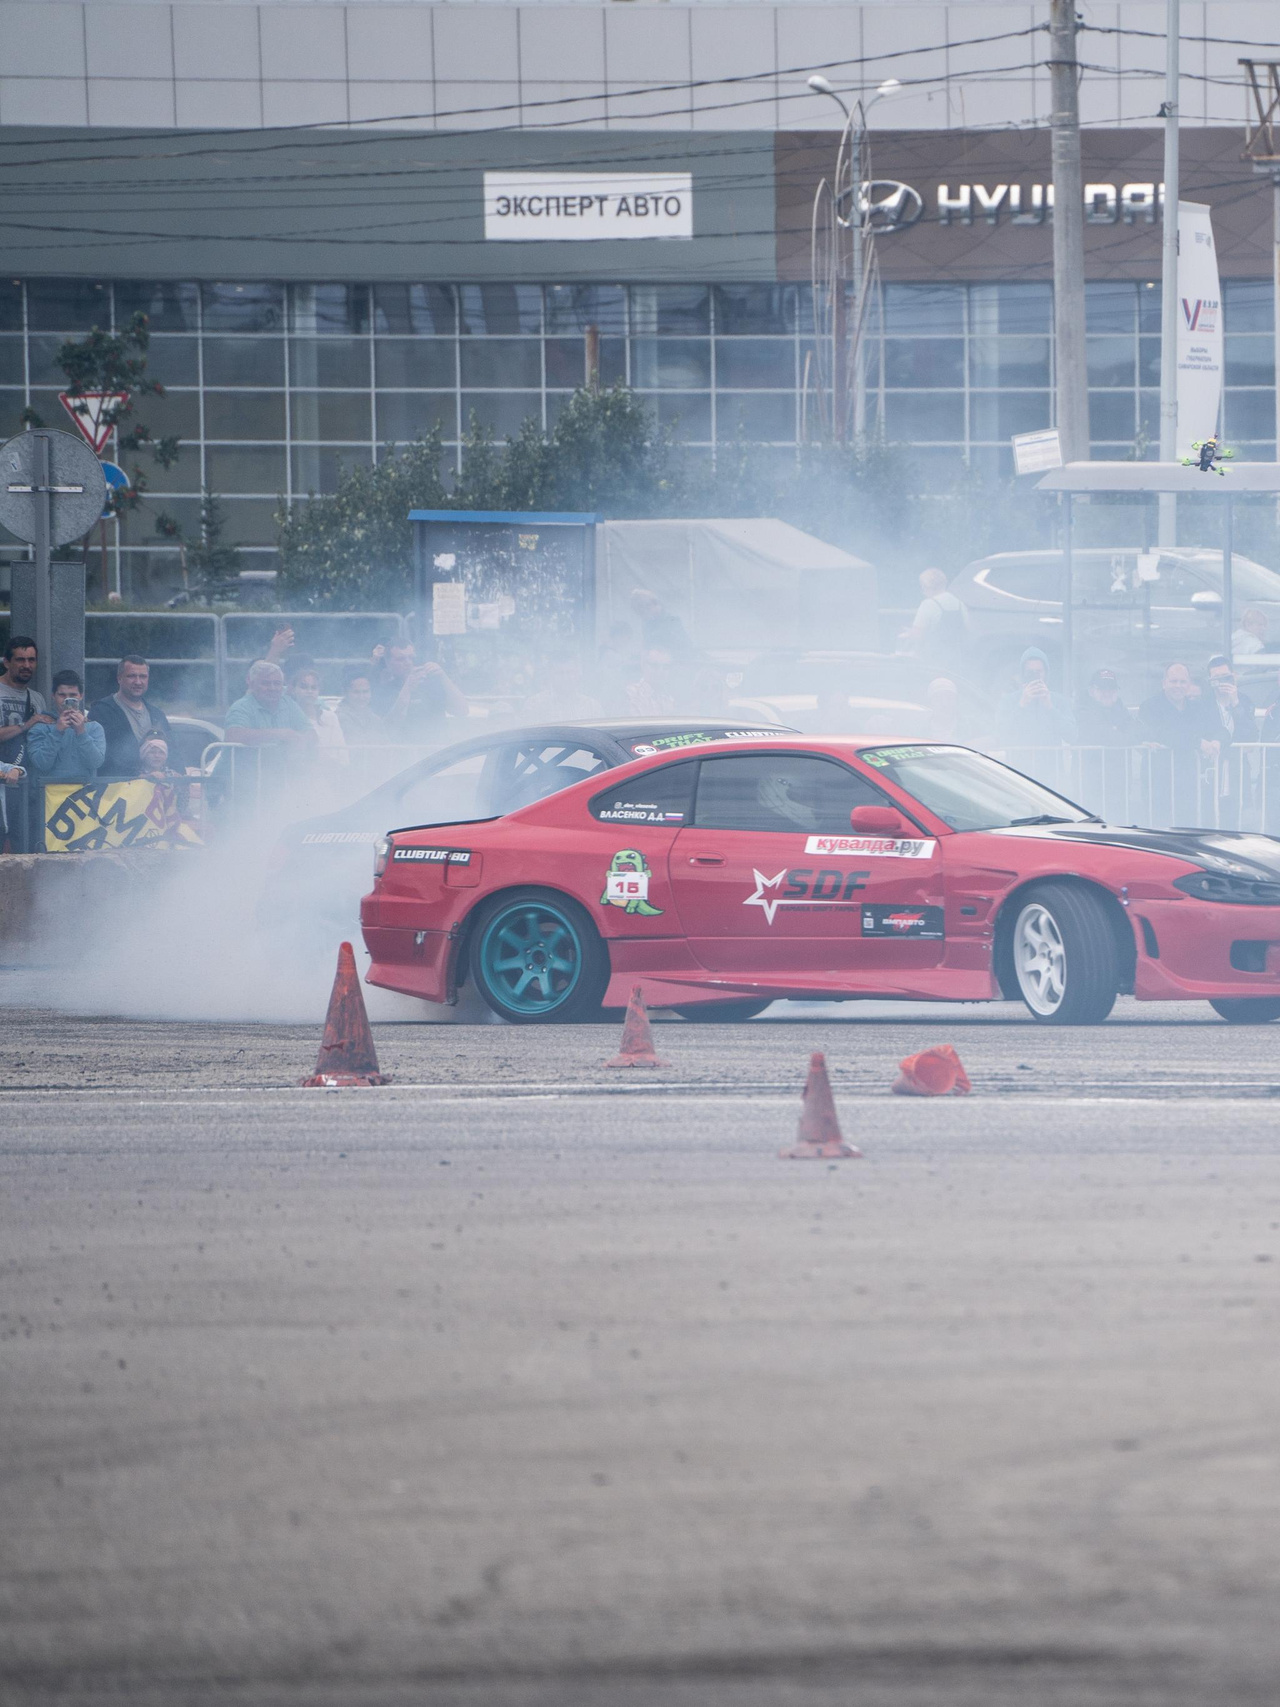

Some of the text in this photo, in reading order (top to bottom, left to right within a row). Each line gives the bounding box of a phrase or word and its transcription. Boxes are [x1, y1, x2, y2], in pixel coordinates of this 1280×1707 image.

[496, 195, 682, 217] ЭКСПЕРТ АВТО
[652, 732, 705, 747] DRIFT
[666, 736, 713, 749] THAT
[600, 810, 647, 820] ВЛАСЕНКО
[302, 832, 379, 844] CLUBTURBO
[816, 838, 925, 856] кувалда.ру
[394, 850, 470, 862] CLUBTURBO
[783, 869, 871, 900] SDF
